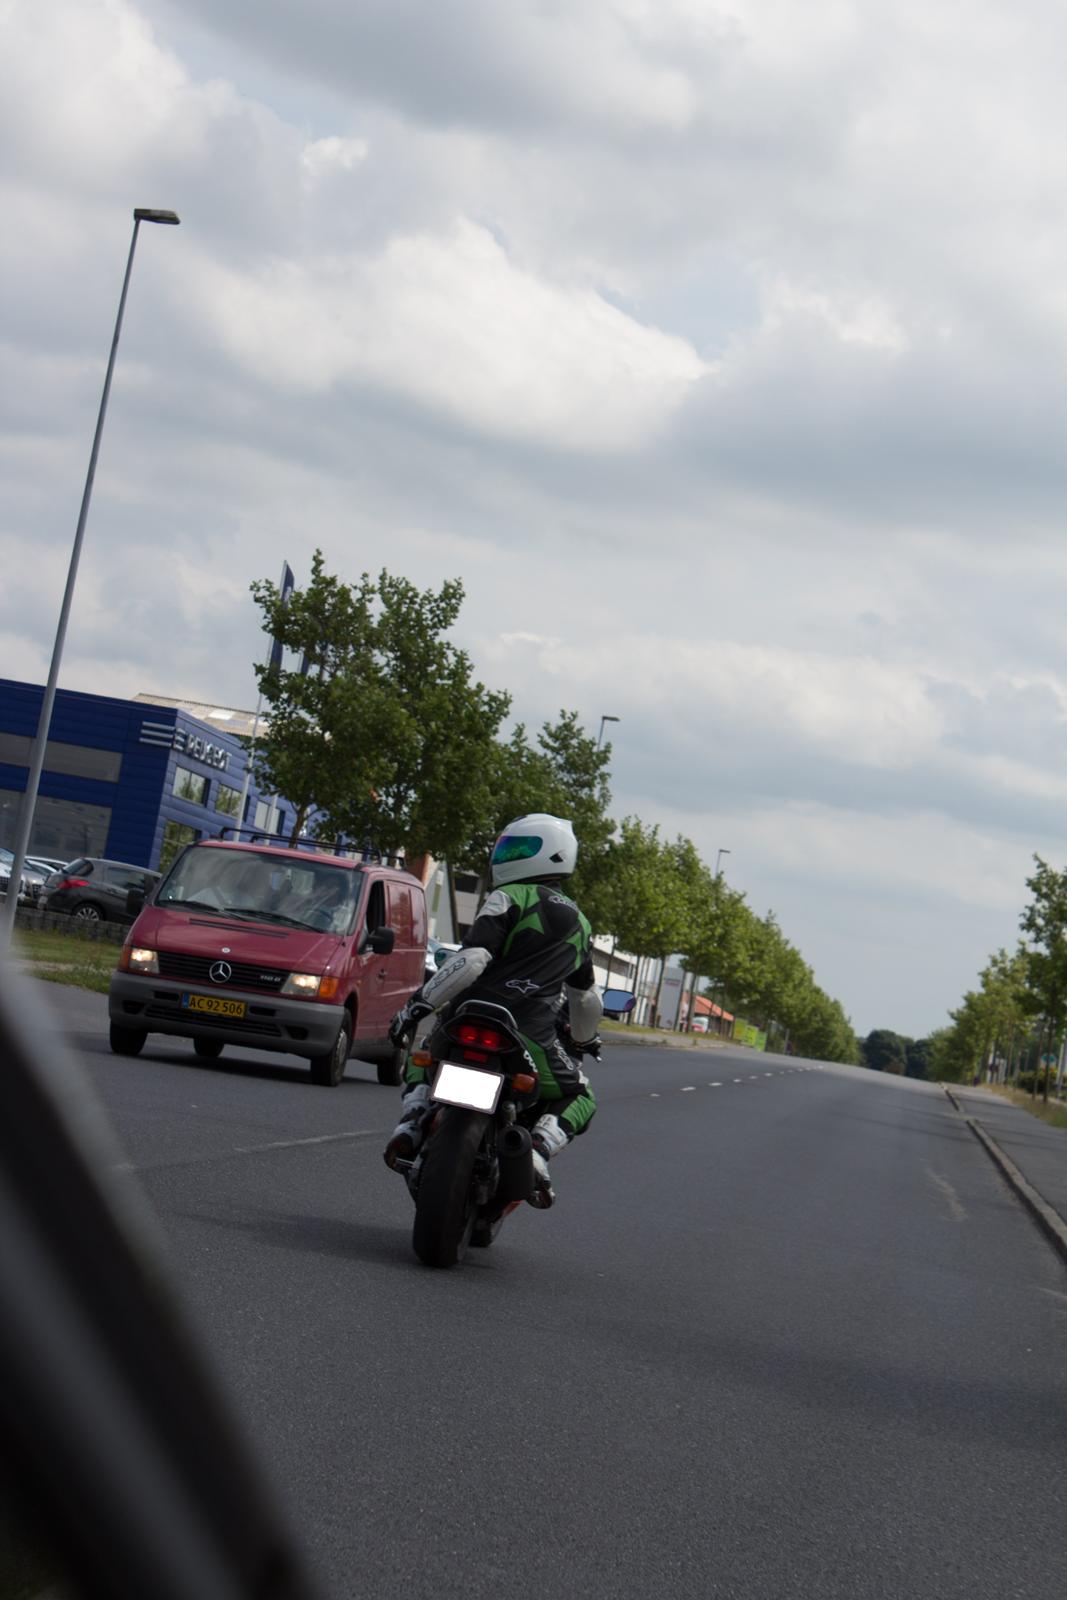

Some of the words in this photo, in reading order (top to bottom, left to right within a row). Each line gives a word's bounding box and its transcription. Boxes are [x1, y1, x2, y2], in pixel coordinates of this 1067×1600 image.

[187, 734, 232, 771] PEUGEOT
[189, 997, 205, 1009] AC
[207, 999, 221, 1012] 92
[222, 1002, 243, 1014] 506
